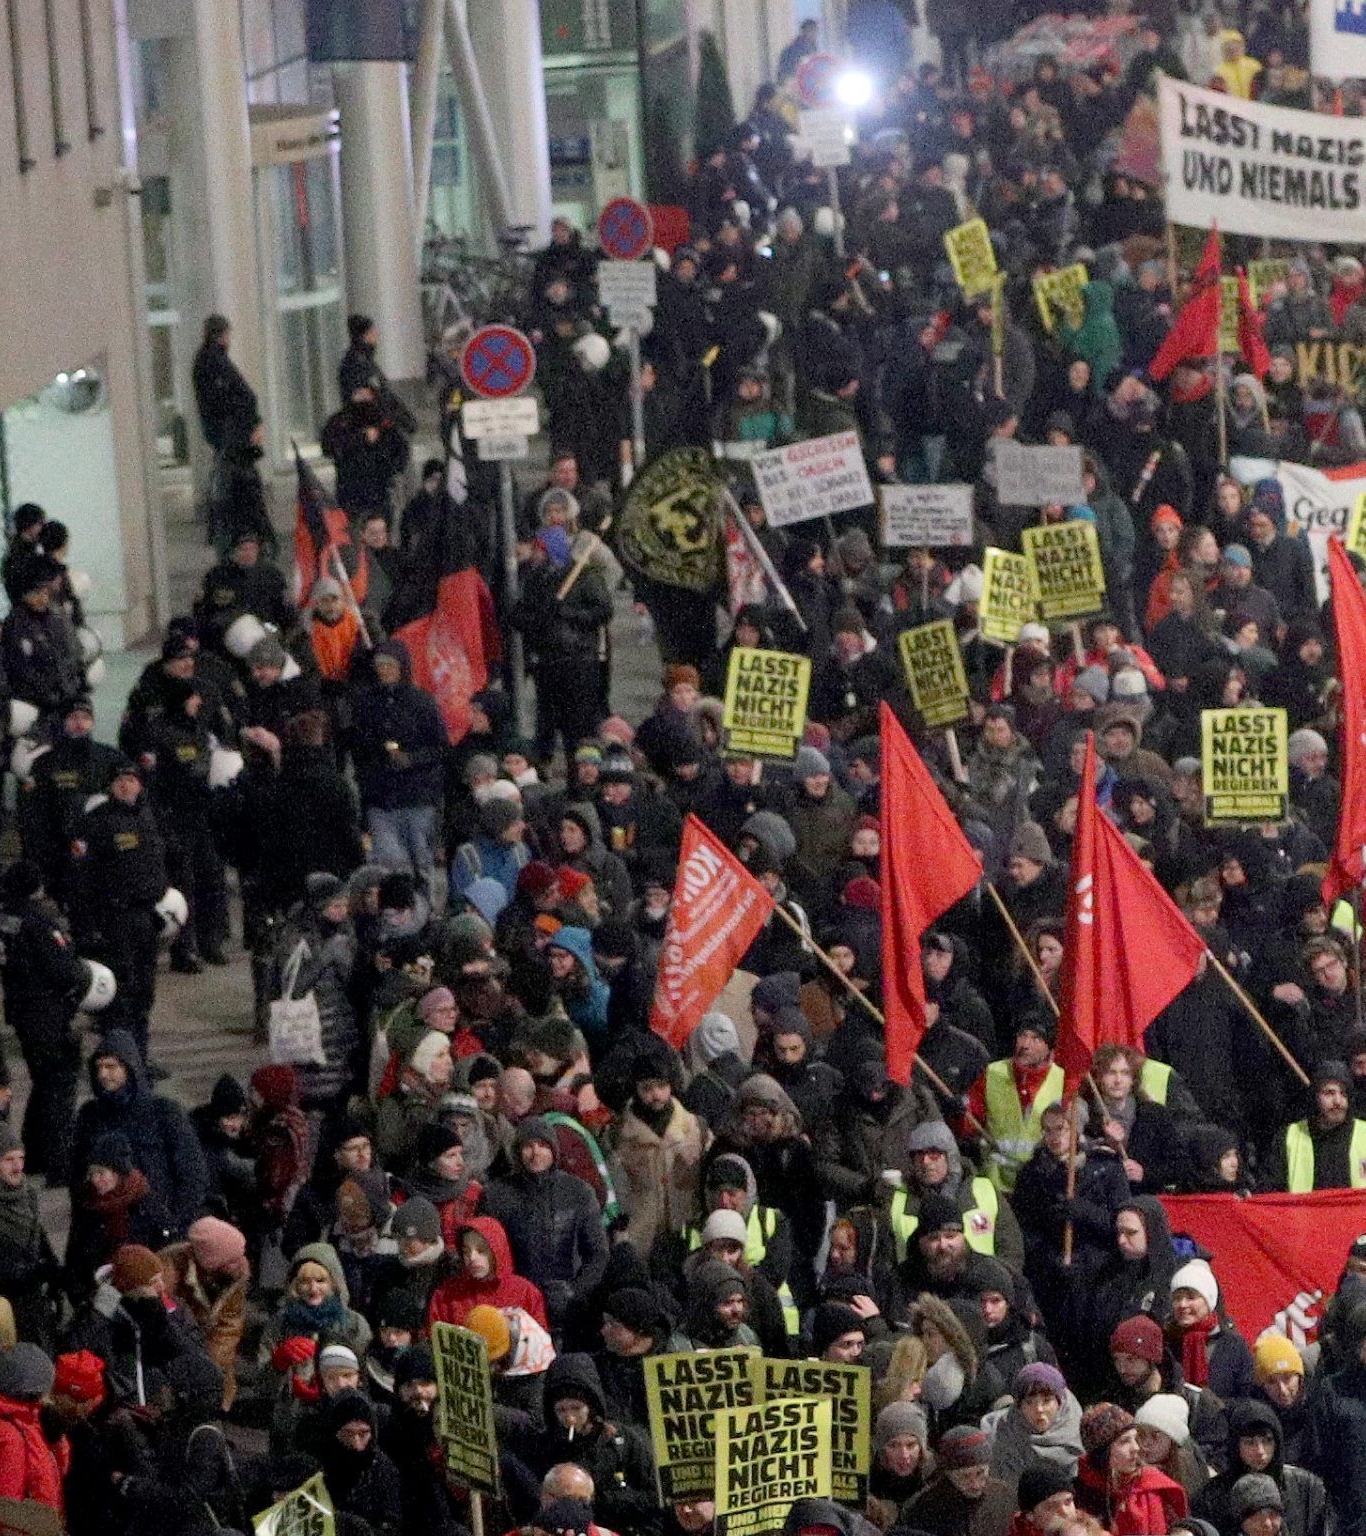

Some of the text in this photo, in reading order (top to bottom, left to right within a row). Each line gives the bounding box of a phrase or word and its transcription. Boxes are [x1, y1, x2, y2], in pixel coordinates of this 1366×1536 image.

[1179, 93, 1261, 150] LASST
[1272, 128, 1365, 167] NAZIS
[1182, 149, 1232, 194] UND
[1239, 163, 1359, 211] NIEMALS
[1031, 526, 1090, 550] LASST
[1036, 544, 1093, 568] NAZIS
[1038, 562, 1096, 589] NICHT
[903, 626, 949, 654] LASST
[738, 655, 801, 677] LASST
[735, 674, 799, 697] NAZIS
[734, 694, 797, 717] NICHT
[1212, 715, 1277, 734] LASST
[1212, 736, 1278, 755] NAZIS
[1213, 757, 1278, 776] NICHT
[437, 1327, 482, 1367] LASST
[441, 1355, 485, 1398] NAZIS
[656, 1353, 750, 1387] LASST
[765, 1366, 859, 1397] LASST
[445, 1384, 487, 1429] NICHT
[660, 1380, 753, 1415] NAZIS
[663, 1413, 716, 1443] NIC
[728, 1402, 819, 1439] LASST
[728, 1425, 819, 1466] NAZIS
[728, 1451, 819, 1492] NICHT
[727, 1478, 819, 1510] REGIEREN
[726, 1510, 756, 1529] UND
